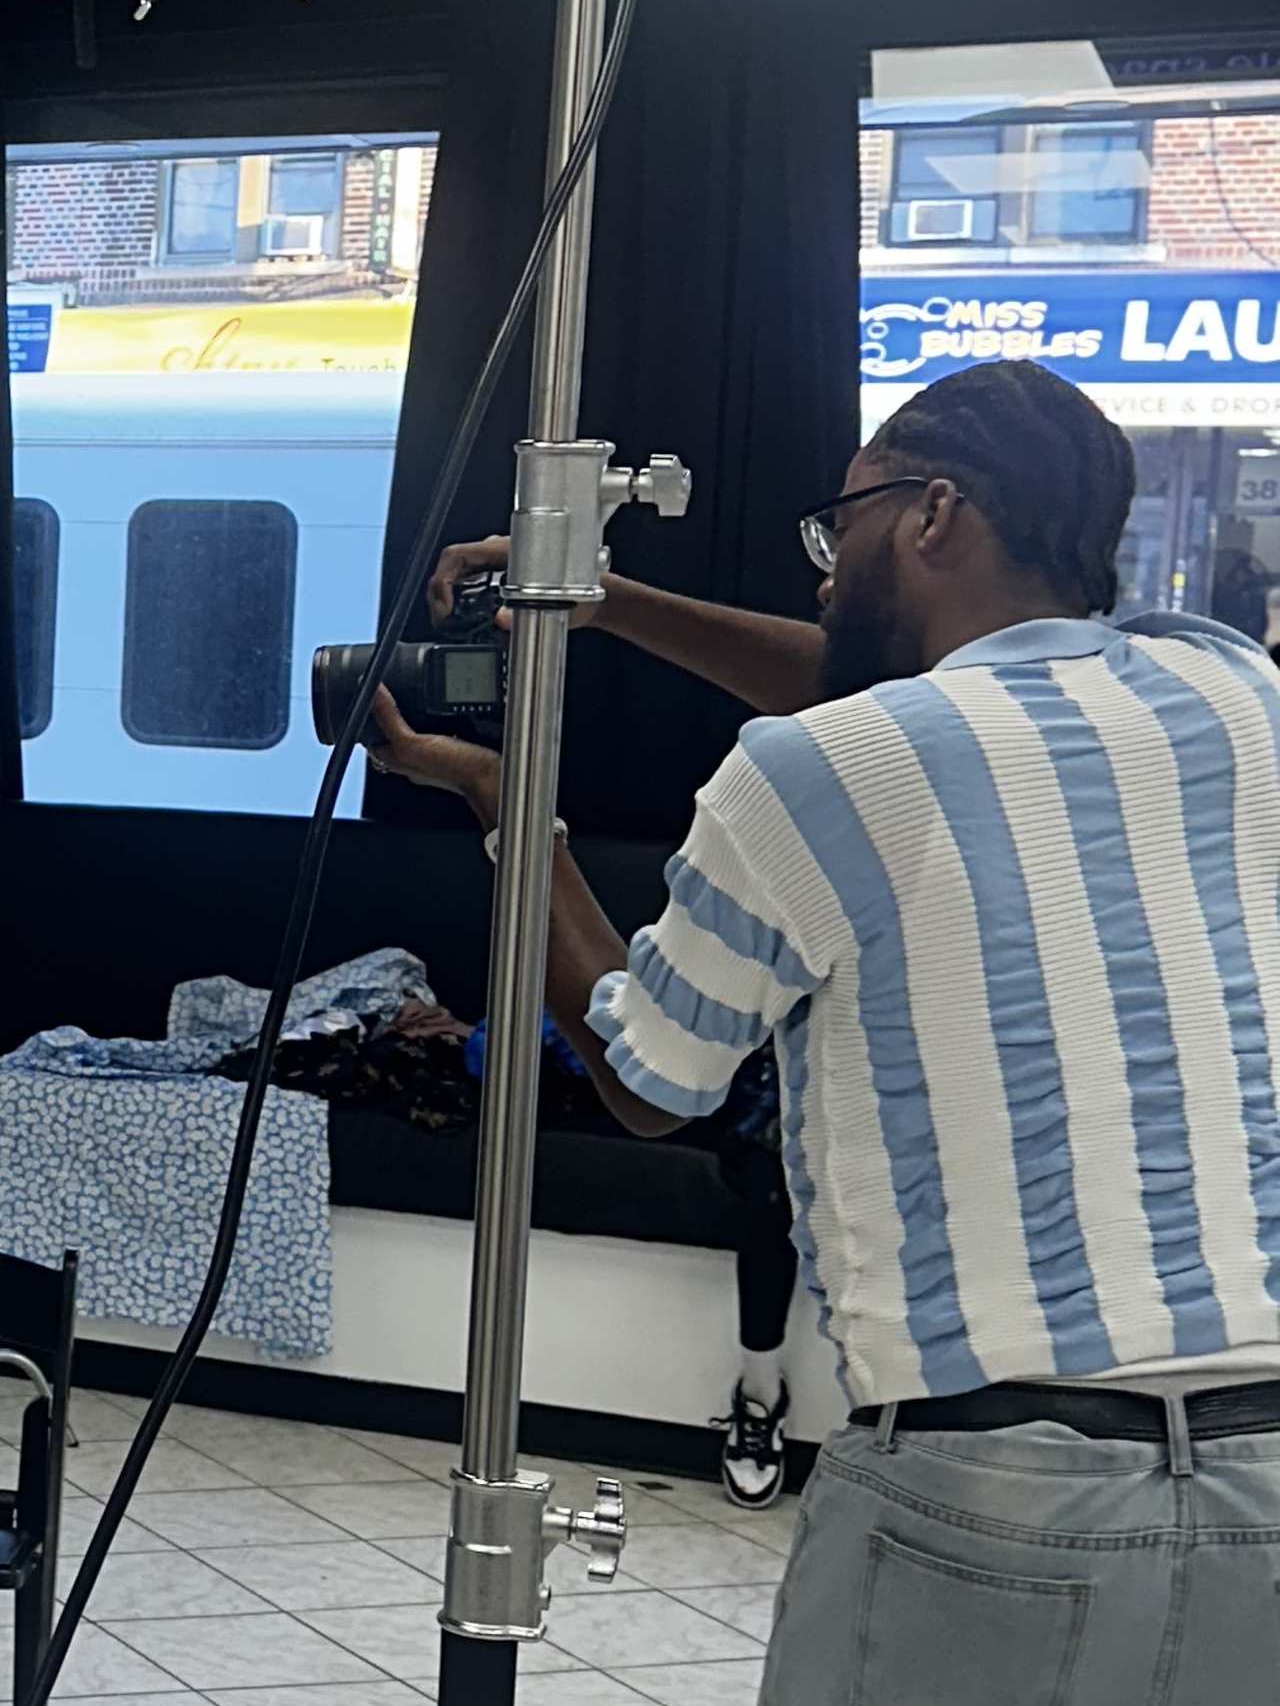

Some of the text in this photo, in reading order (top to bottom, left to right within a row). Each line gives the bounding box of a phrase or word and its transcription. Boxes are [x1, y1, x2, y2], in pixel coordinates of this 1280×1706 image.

[945, 299, 1049, 329] MISS
[920, 329, 1104, 359] BUBBLES
[1120, 299, 1280, 363] LAU
